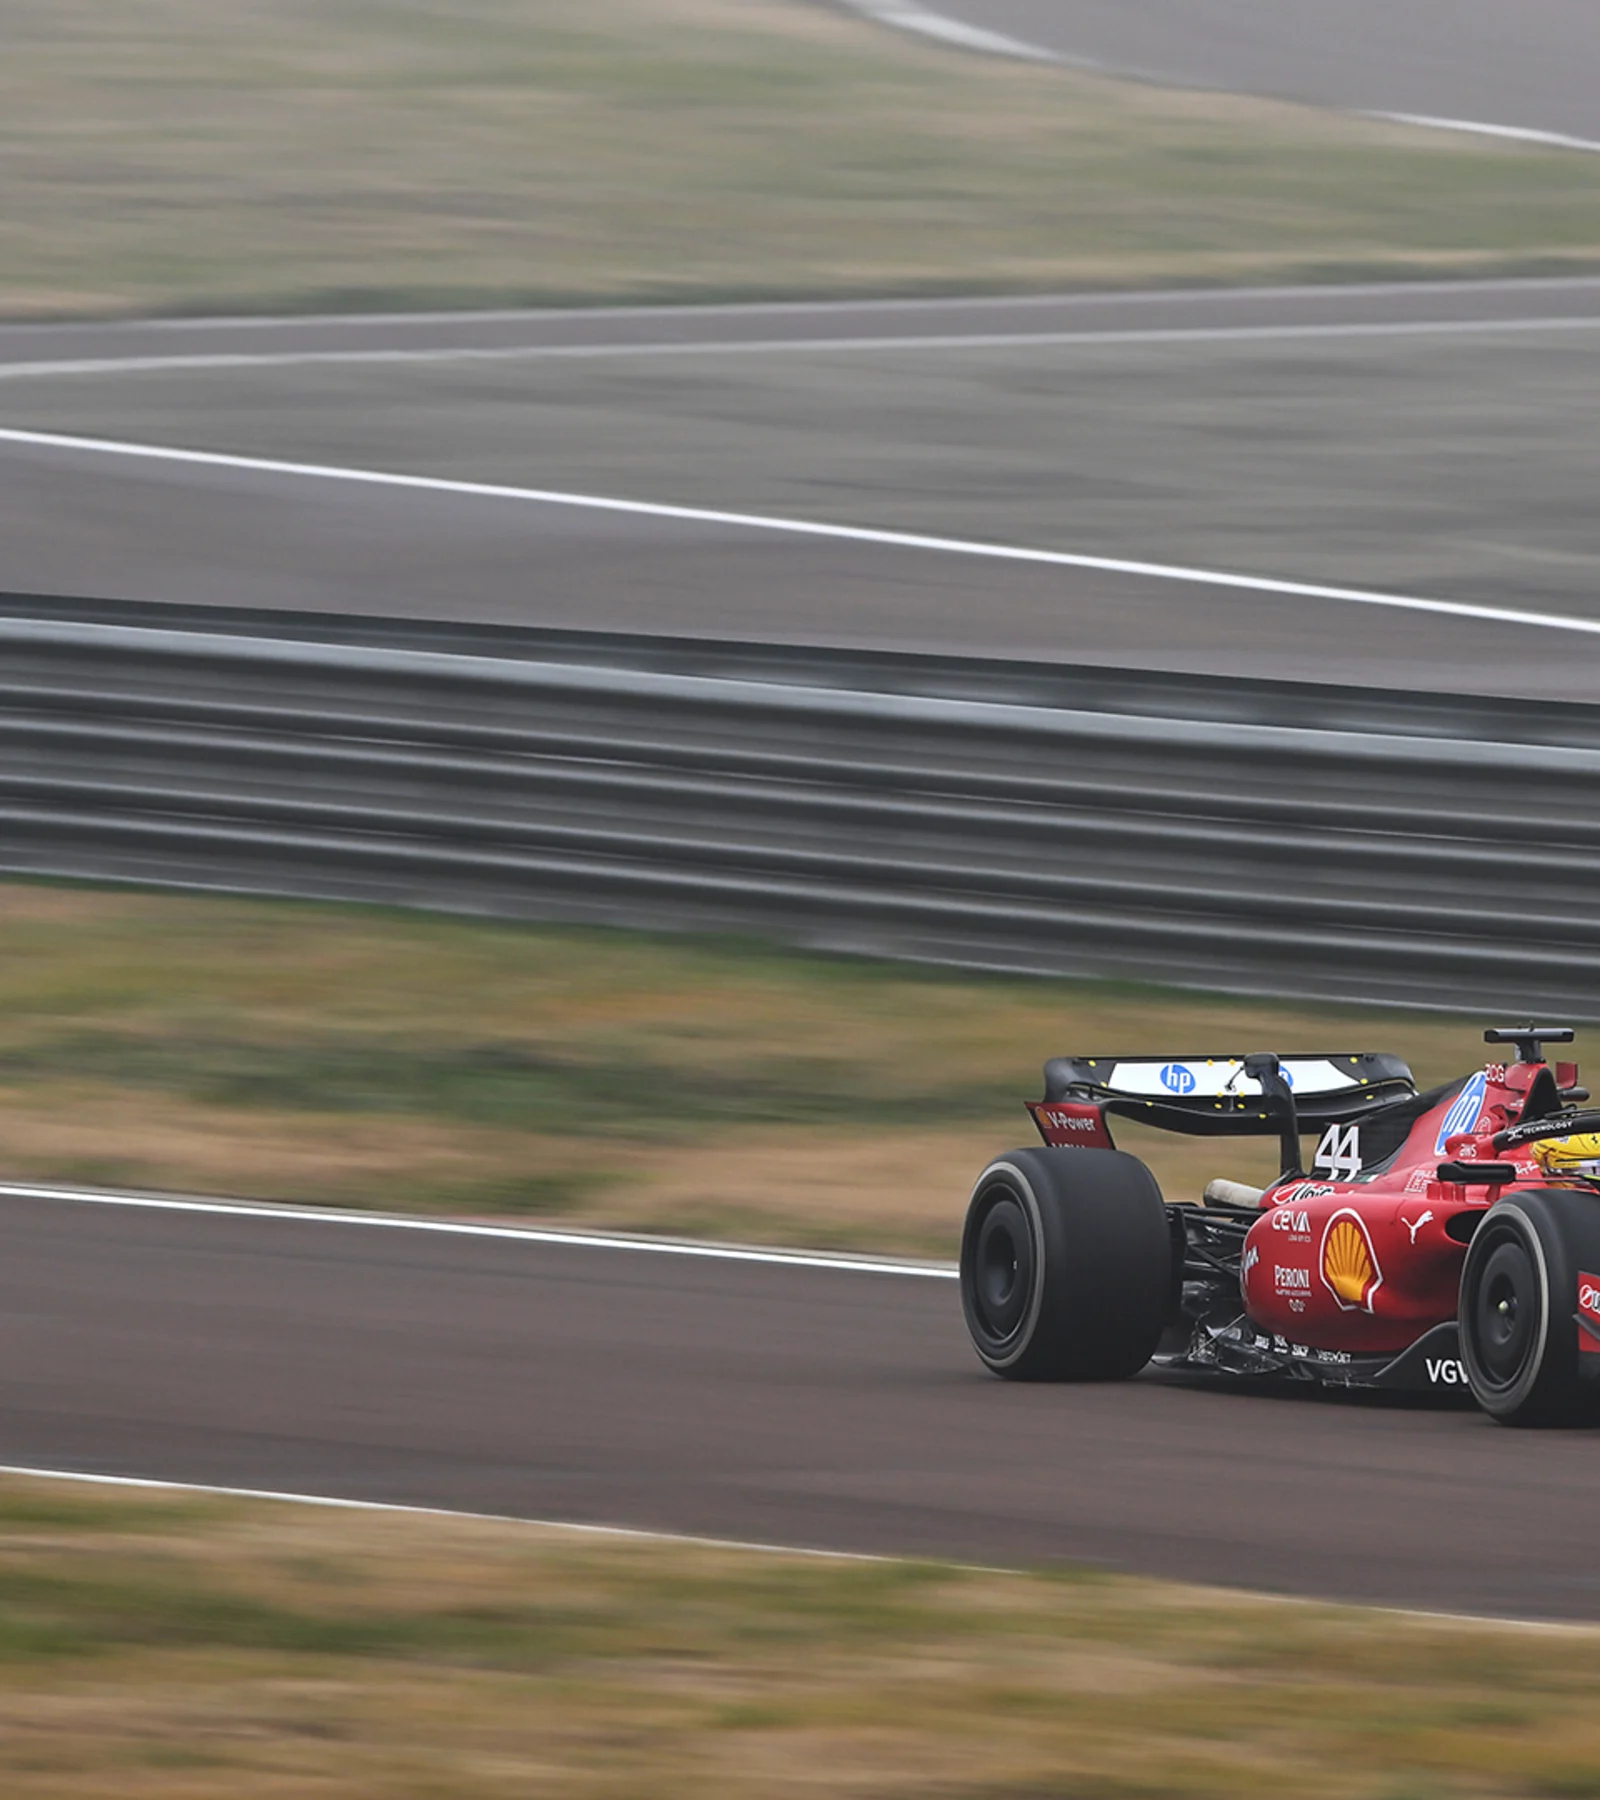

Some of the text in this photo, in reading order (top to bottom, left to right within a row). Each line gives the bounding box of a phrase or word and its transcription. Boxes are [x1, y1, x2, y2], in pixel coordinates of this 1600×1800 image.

[1165, 1064, 1192, 1094] hp
[1047, 1110, 1096, 1132] V-Power
[1523, 1121, 1573, 1135] TECHNOLOGY
[1315, 1123, 1362, 1182] 44
[1274, 1264, 1310, 1288] PERONI
